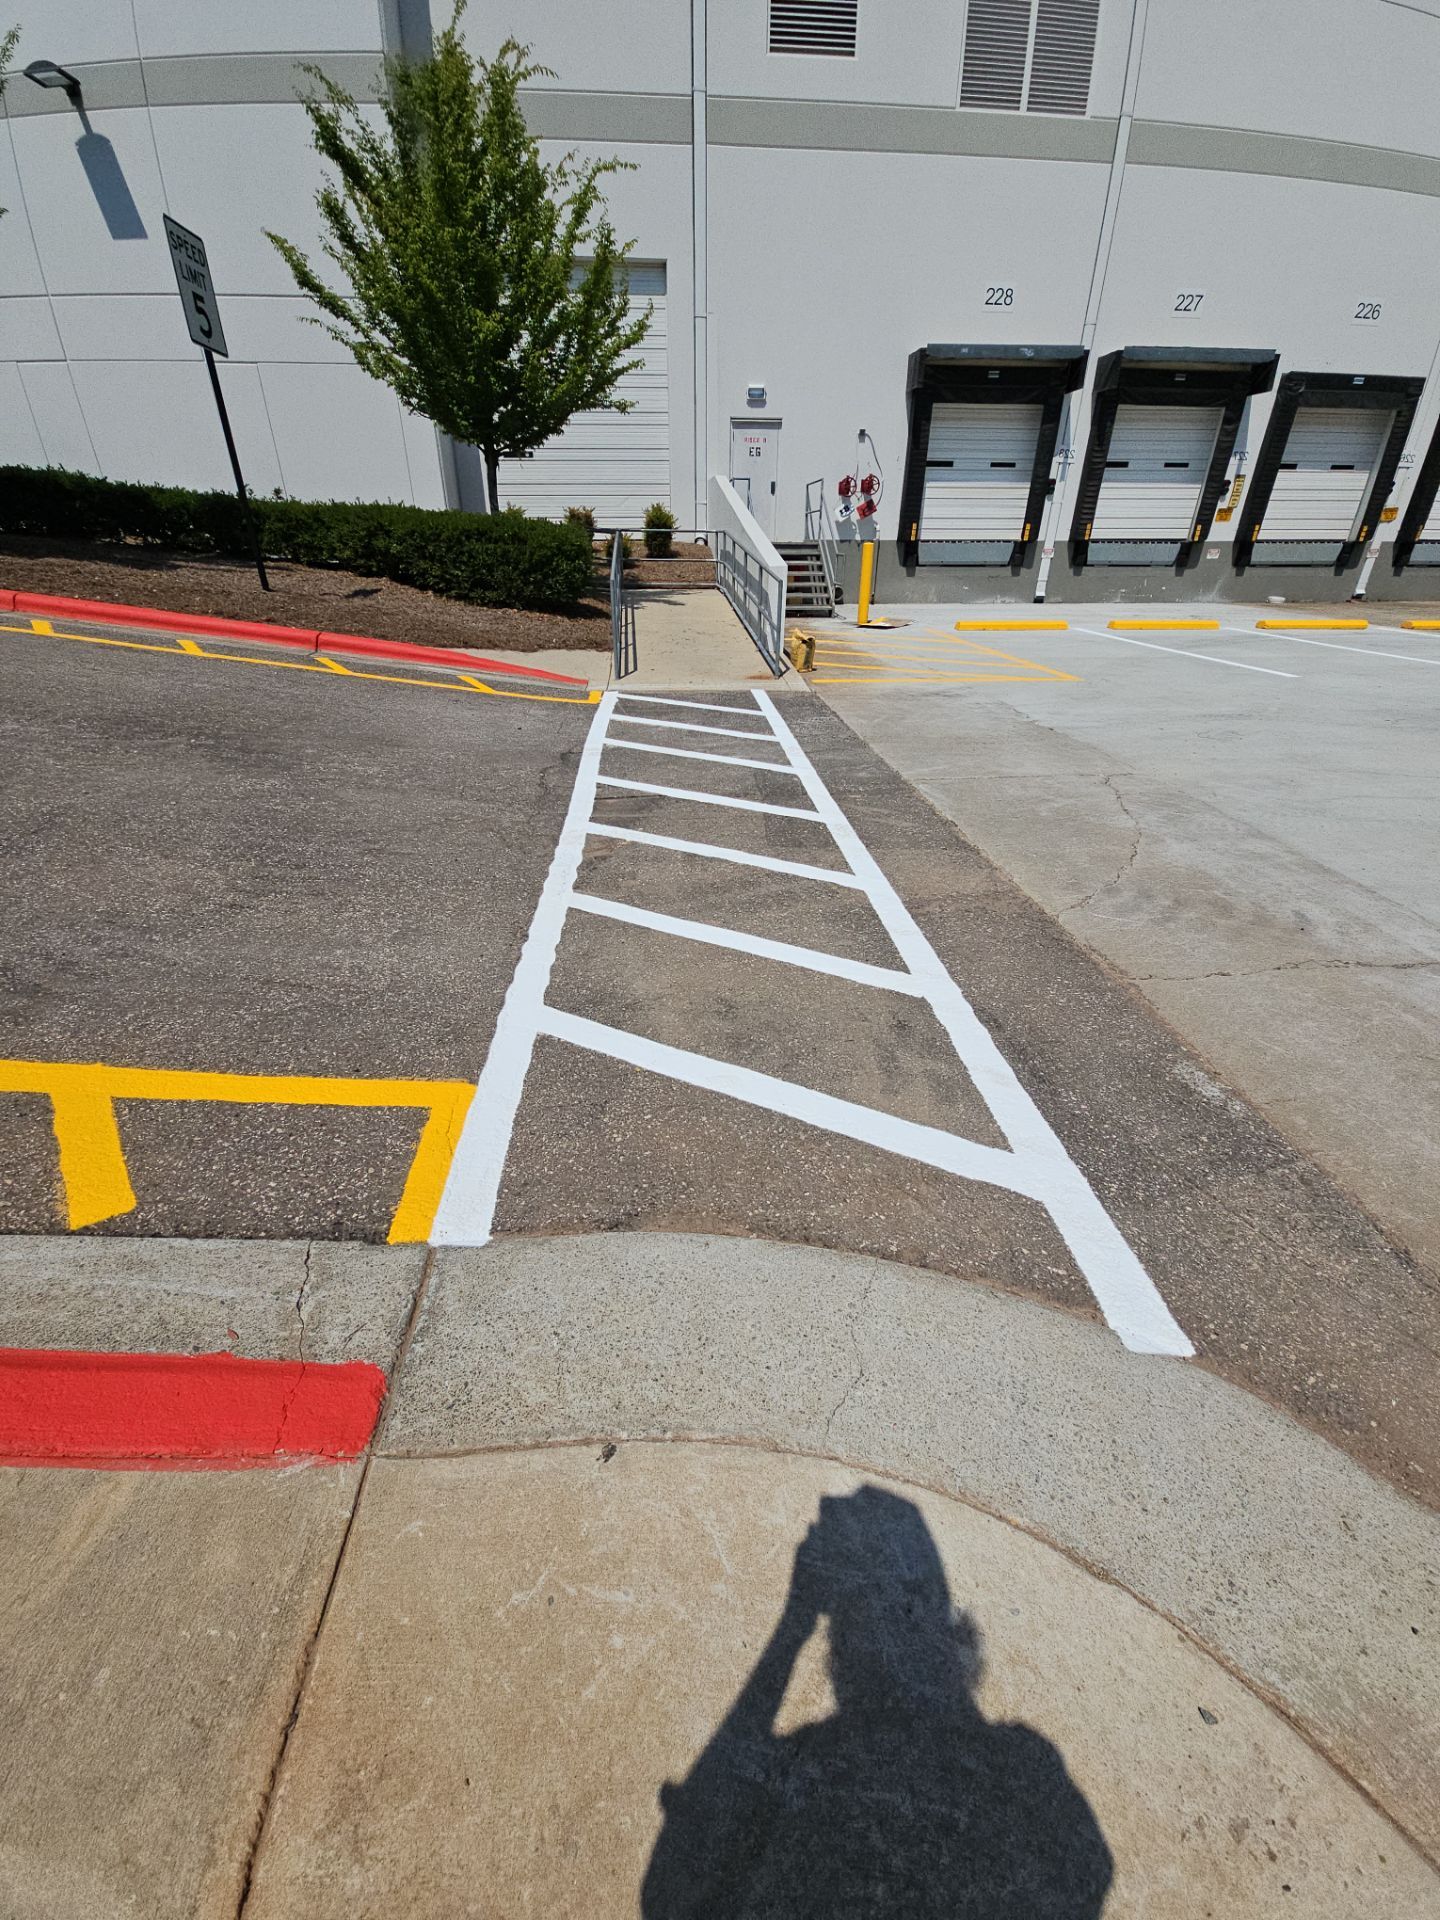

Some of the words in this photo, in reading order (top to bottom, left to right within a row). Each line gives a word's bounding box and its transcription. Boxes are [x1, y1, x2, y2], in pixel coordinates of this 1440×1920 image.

[169, 230, 206, 267] SPEED
[178, 259, 206, 292] LIMIT
[984, 287, 1014, 307] 228
[1174, 294, 1204, 312] 227
[192, 290, 213, 338] 5
[1354, 302, 1382, 321] 226
